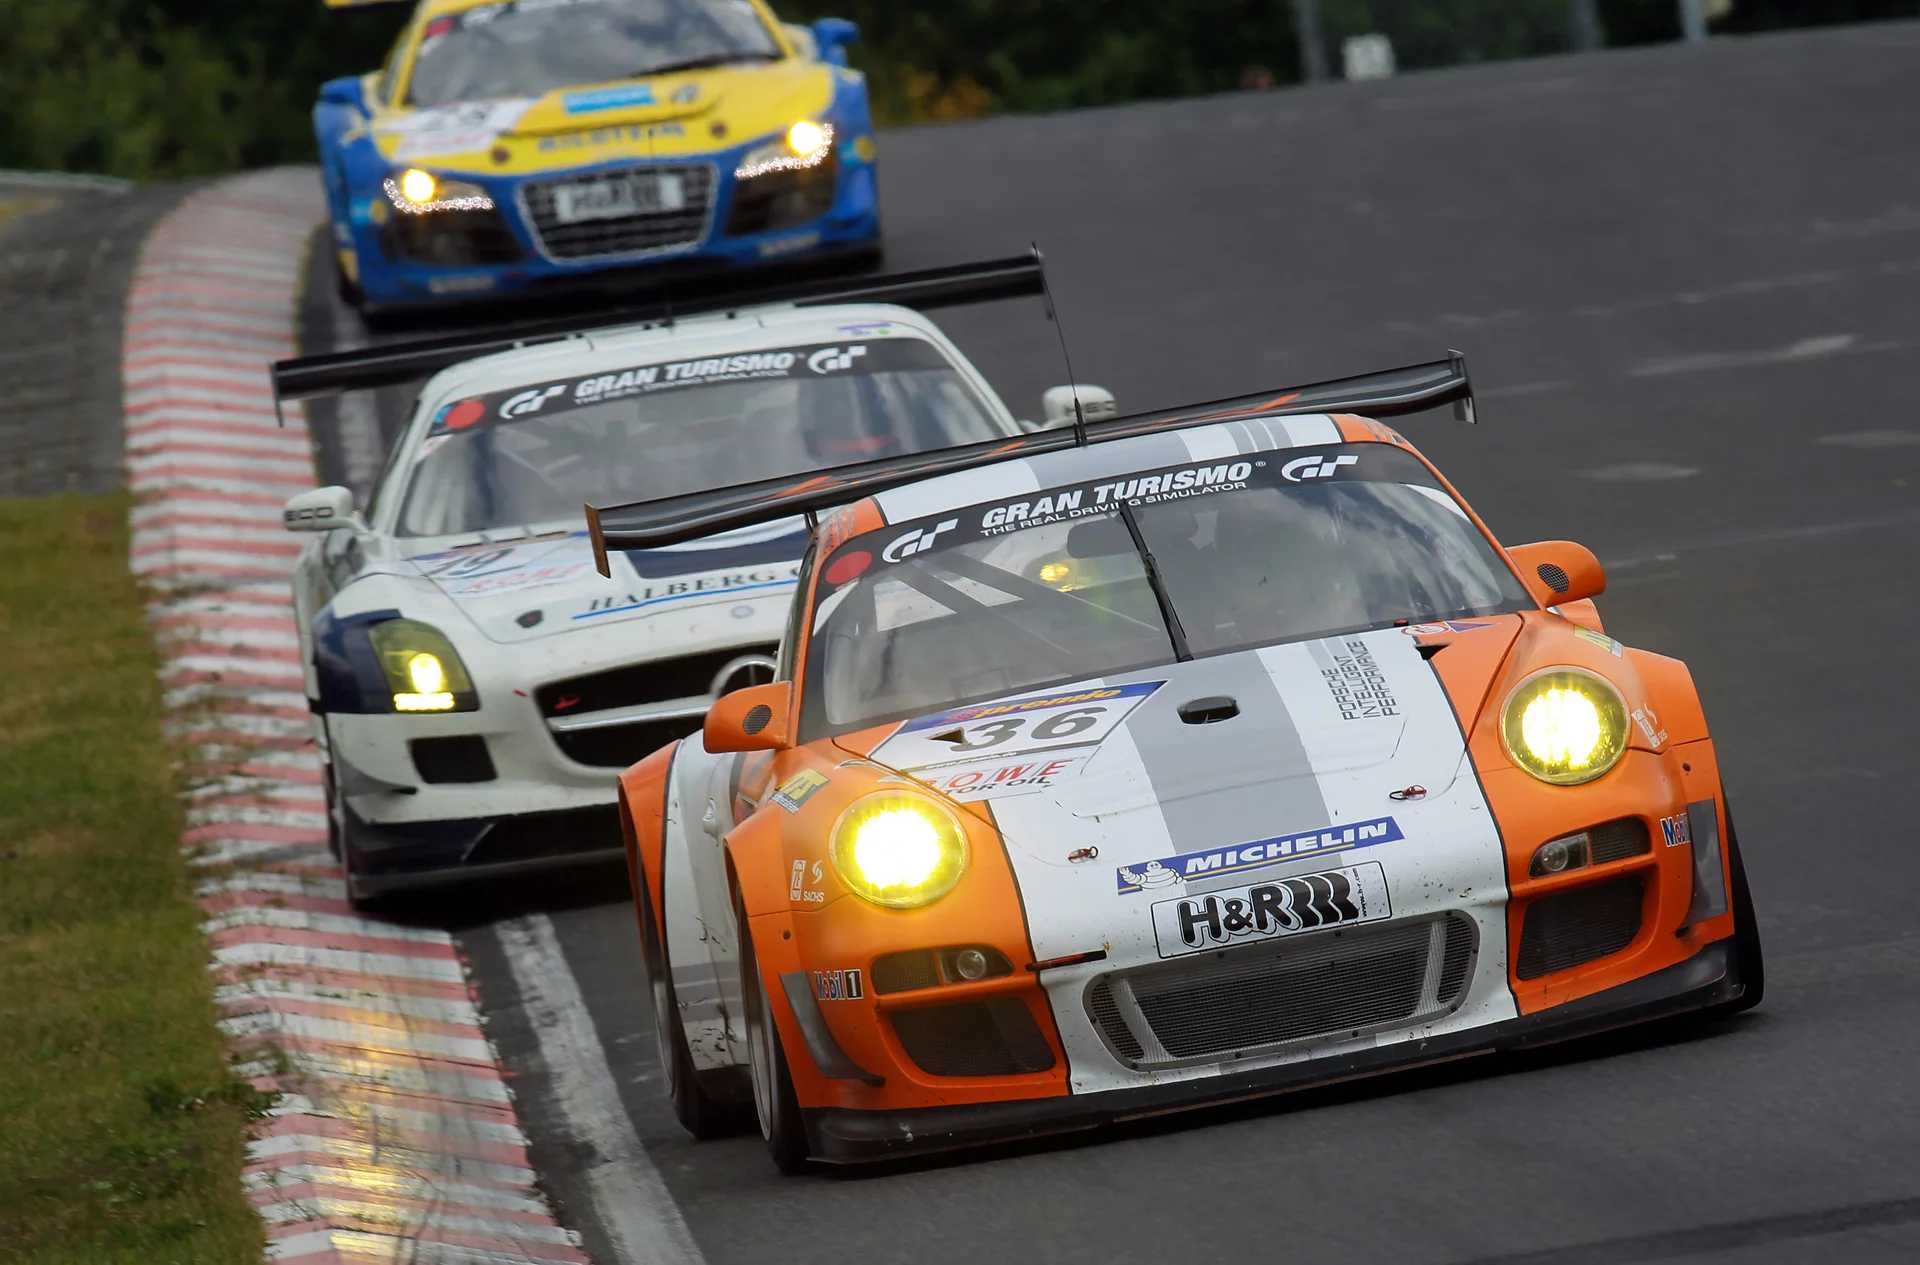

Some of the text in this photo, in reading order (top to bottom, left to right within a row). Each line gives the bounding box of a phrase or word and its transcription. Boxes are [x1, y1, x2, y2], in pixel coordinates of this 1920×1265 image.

[574, 352, 795, 399] GRAN TURISMO
[980, 481, 1247, 538] THE REAL DRIVIG SIMULATOR
[981, 461, 1252, 529] GRAN TURISMO
[589, 569, 776, 612] HALBERG
[1321, 668, 1361, 721] PORSCHE
[1334, 656, 1381, 719] INTELLIGENT
[1346, 640, 1400, 717] PERFORMANCE
[948, 706, 1108, 752] 36
[973, 690, 1123, 718] premio
[1006, 777, 1051, 787] OIL
[1184, 822, 1388, 875] MICHELIN
[803, 891, 825, 903] SACHS
[1351, 866, 1369, 919] www.h-r.com
[814, 970, 845, 1001] Mobil
